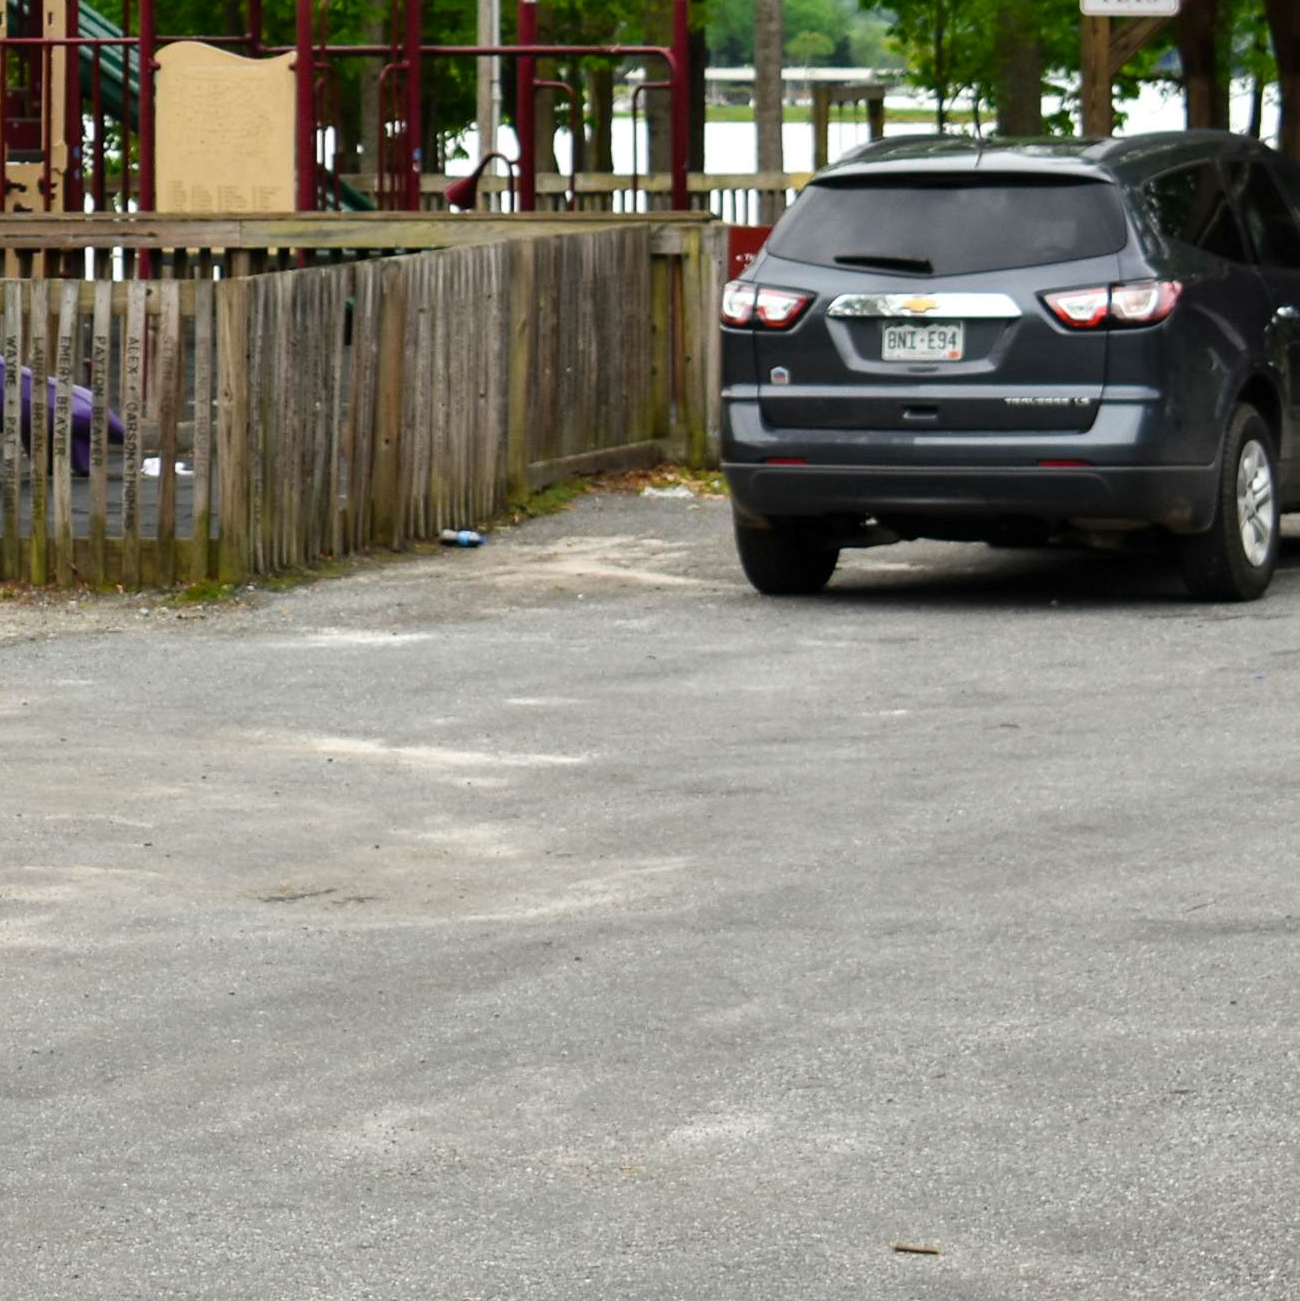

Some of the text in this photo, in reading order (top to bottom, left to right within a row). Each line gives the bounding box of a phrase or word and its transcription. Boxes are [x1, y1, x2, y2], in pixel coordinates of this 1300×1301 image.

[5, 335, 18, 387] WAYNE
[127, 336, 139, 375] ALEX
[56, 336, 72, 457] EMERY BEAVER
[91, 335, 106, 467] PAYTON BEAVER
[5, 416, 16, 446] PAT
[126, 402, 138, 461] CARSON
